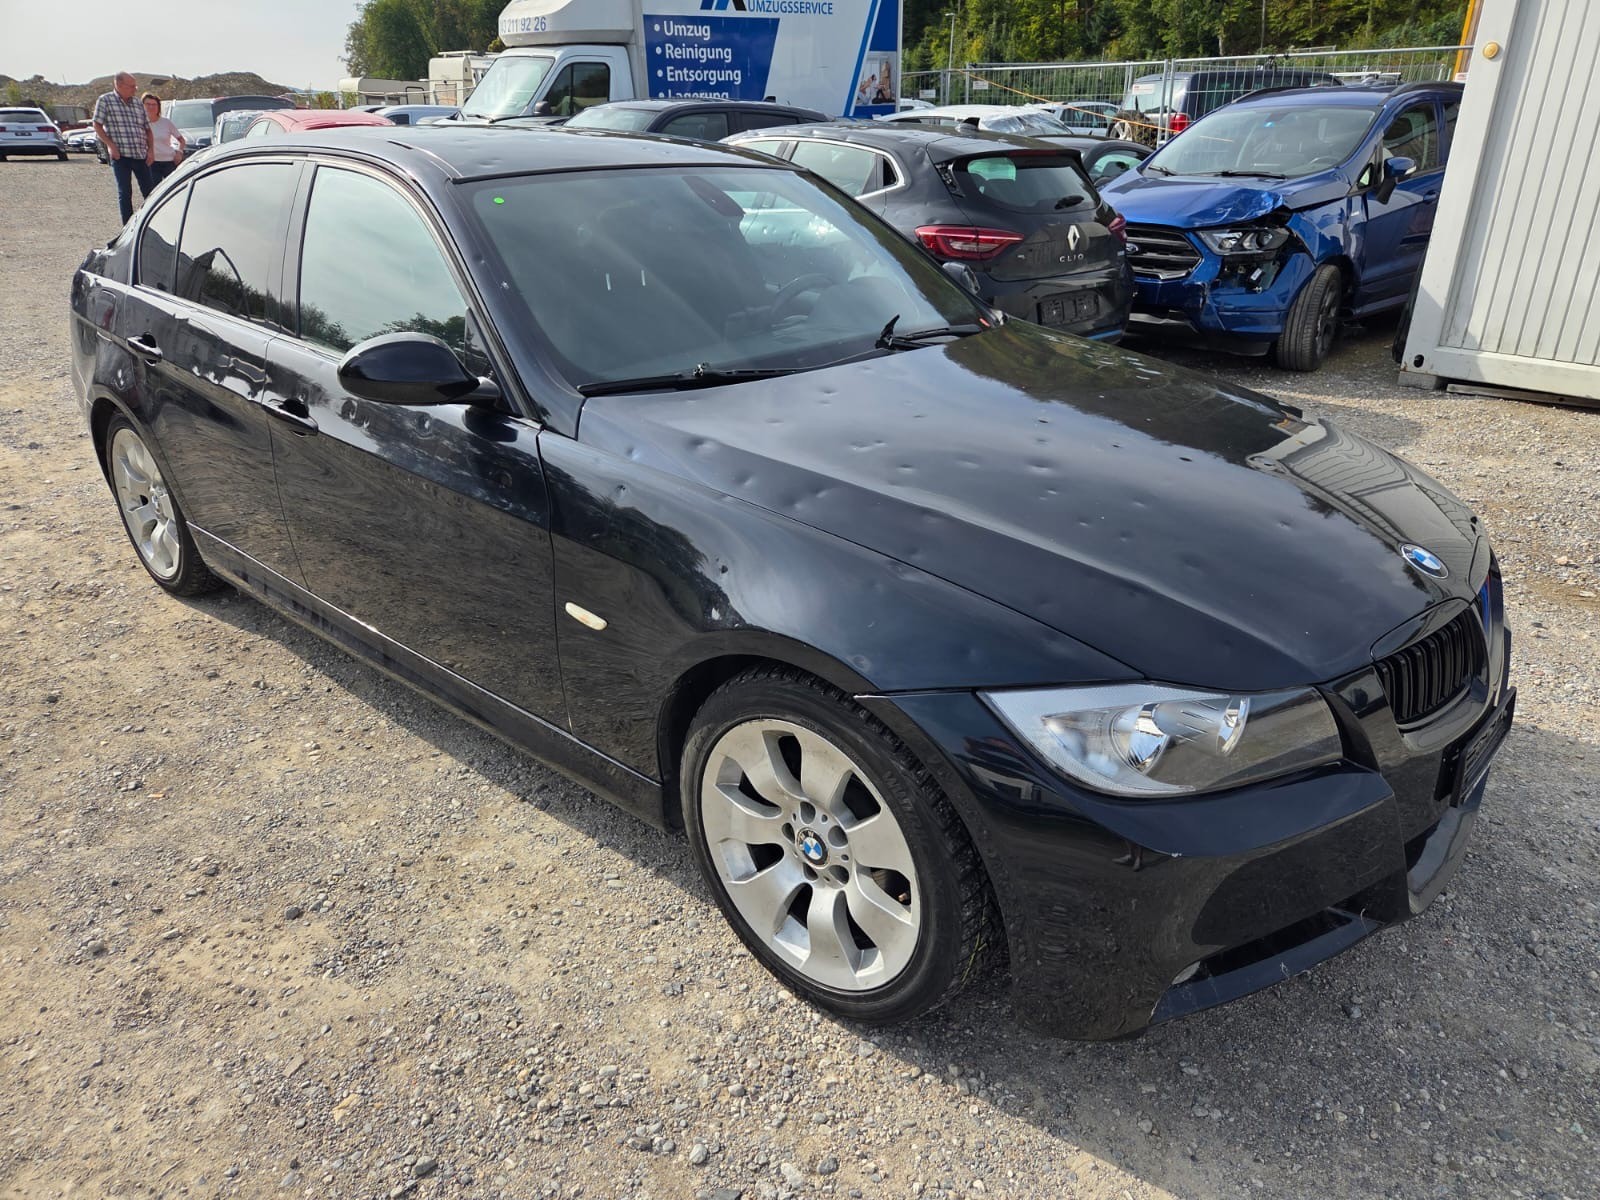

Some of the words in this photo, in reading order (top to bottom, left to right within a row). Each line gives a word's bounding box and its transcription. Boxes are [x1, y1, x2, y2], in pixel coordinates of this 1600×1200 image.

[748, 0, 833, 15] UMZUGSSERVICE
[520, 17, 531, 31] 92
[534, 16, 546, 31] 26
[663, 21, 711, 41] Umzug
[665, 43, 732, 63] Reinigung
[666, 66, 742, 86] Entsorgung
[1059, 253, 1084, 262] CLIO
